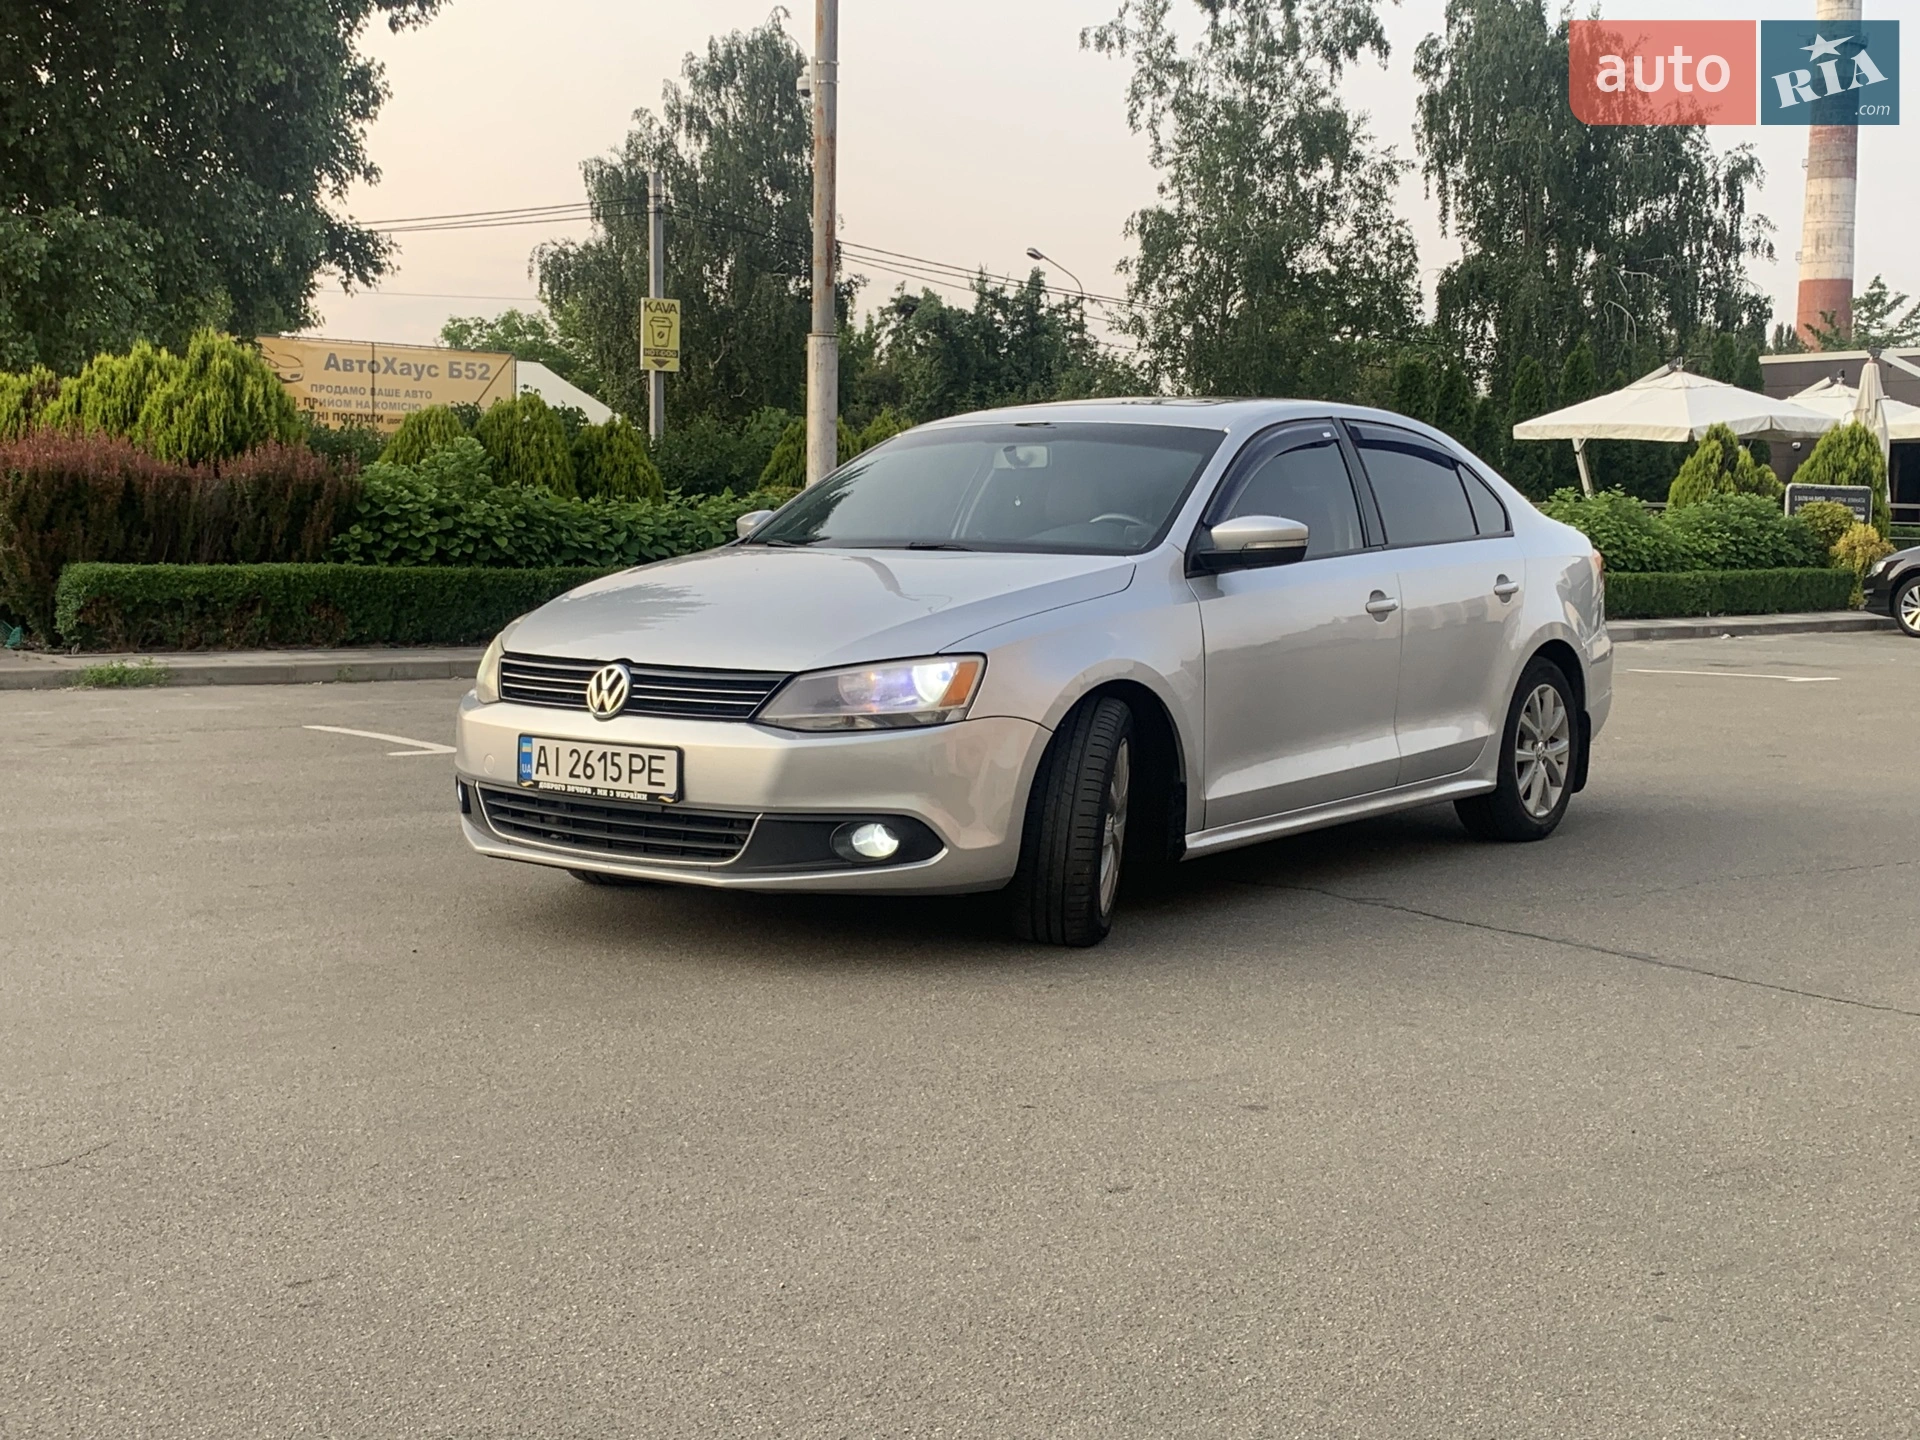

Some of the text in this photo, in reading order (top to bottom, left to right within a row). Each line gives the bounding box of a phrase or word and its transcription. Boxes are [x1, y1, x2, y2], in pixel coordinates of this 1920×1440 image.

[644, 301, 678, 314] KAVA
[644, 349, 678, 358] HOT-DOG
[323, 352, 491, 382] АвтоХаус Б52
[310, 383, 433, 400] ПРОДАМО ВАШЕ АВТО
[304, 397, 352, 409] ПРИЙОМ
[355, 400, 371, 410] НА
[373, 401, 422, 412] КОМІСІЮ
[333, 412, 384, 424] ПОСЛУГИ
[521, 763, 532, 774] UA
[535, 745, 666, 787] AI 2615 PE
